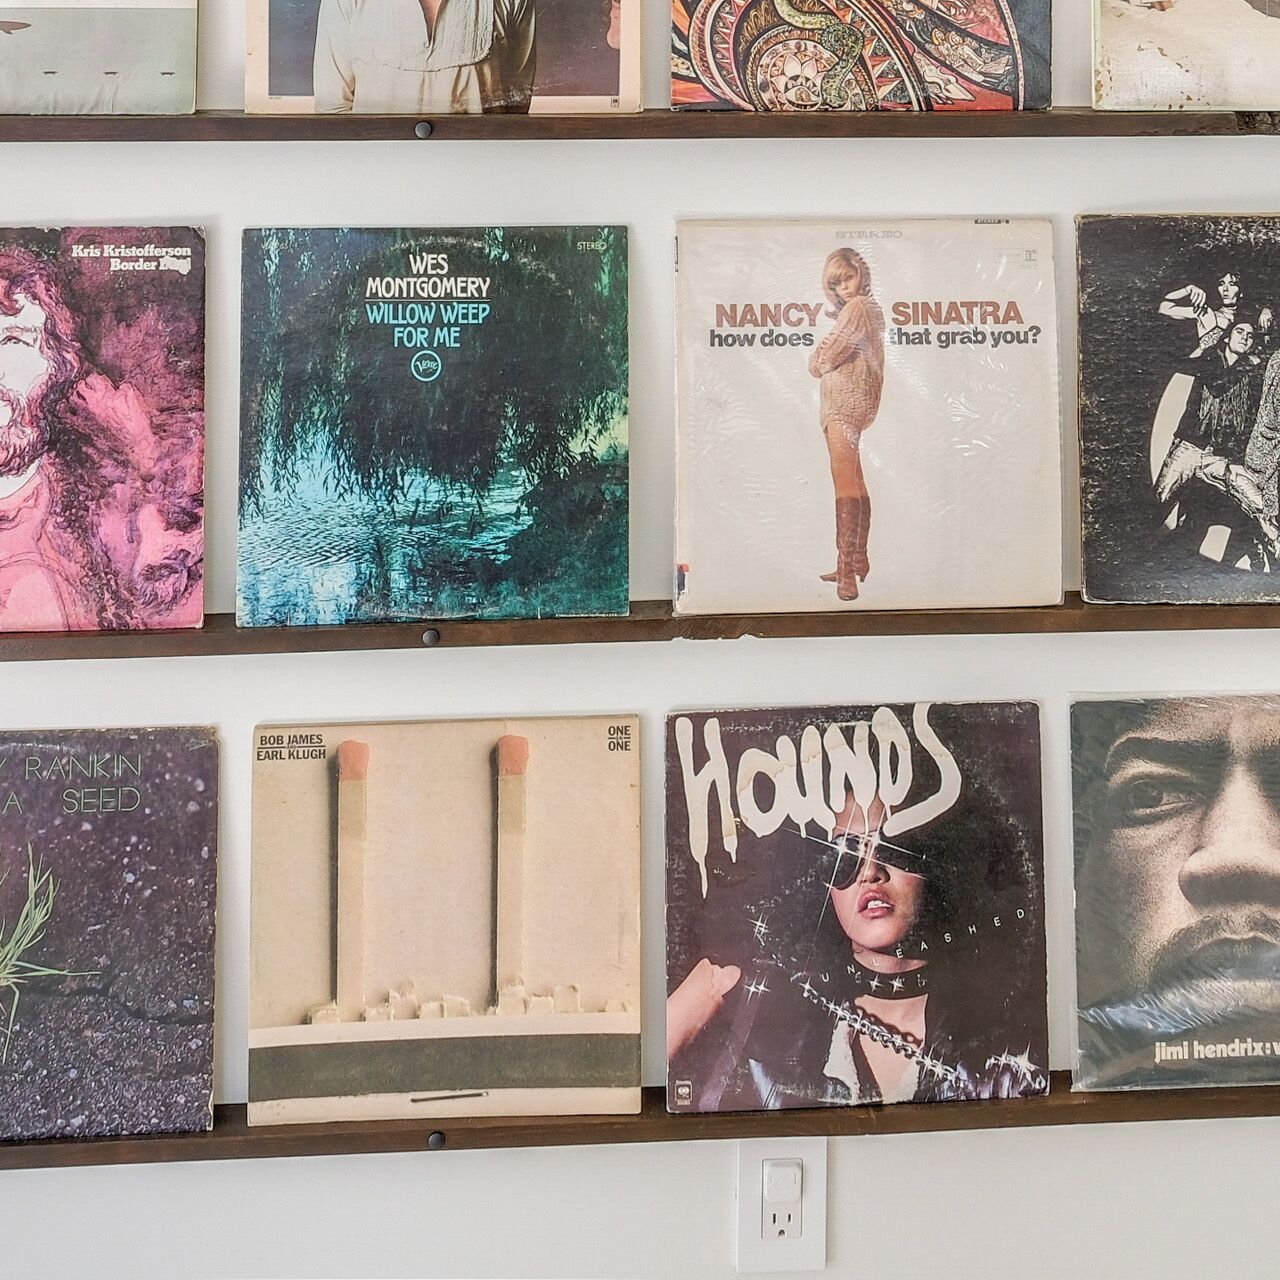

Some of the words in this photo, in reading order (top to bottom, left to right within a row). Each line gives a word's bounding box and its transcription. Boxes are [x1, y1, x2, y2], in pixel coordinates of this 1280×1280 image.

[577, 241, 607, 250] STEREO
[835, 230, 903, 239] STEREO
[71, 245, 101, 257] Kris
[103, 244, 192, 257] Kristofferson
[110, 258, 158, 271] Border
[409, 253, 448, 276] WES
[365, 276, 490, 298] MONTGOMERY
[365, 302, 437, 324] WILLOW
[440, 302, 490, 324] WEEP
[715, 303, 824, 328] NANCY
[891, 301, 1024, 326] SINATRA
[393, 327, 429, 348] FOR
[434, 327, 461, 347] ME
[709, 329, 756, 347] how
[760, 329, 814, 347] does
[888, 328, 931, 346] that
[937, 326, 987, 349] grab
[991, 325, 1041, 349] you?
[260, 735, 284, 746] BOB
[287, 734, 323, 746] JAMES
[608, 725, 631, 737] ONE
[257, 749, 286, 761] EARL
[288, 749, 326, 760] KLUGH
[608, 740, 631, 752] ONE
[24, 753, 142, 781] RANKIN
[675, 703, 962, 865] HOUNDS
[2, 791, 23, 815] A
[62, 787, 141, 816] SEED
[822, 908, 1025, 983] UNLEASHED
[1154, 1041, 1188, 1063] jimi
